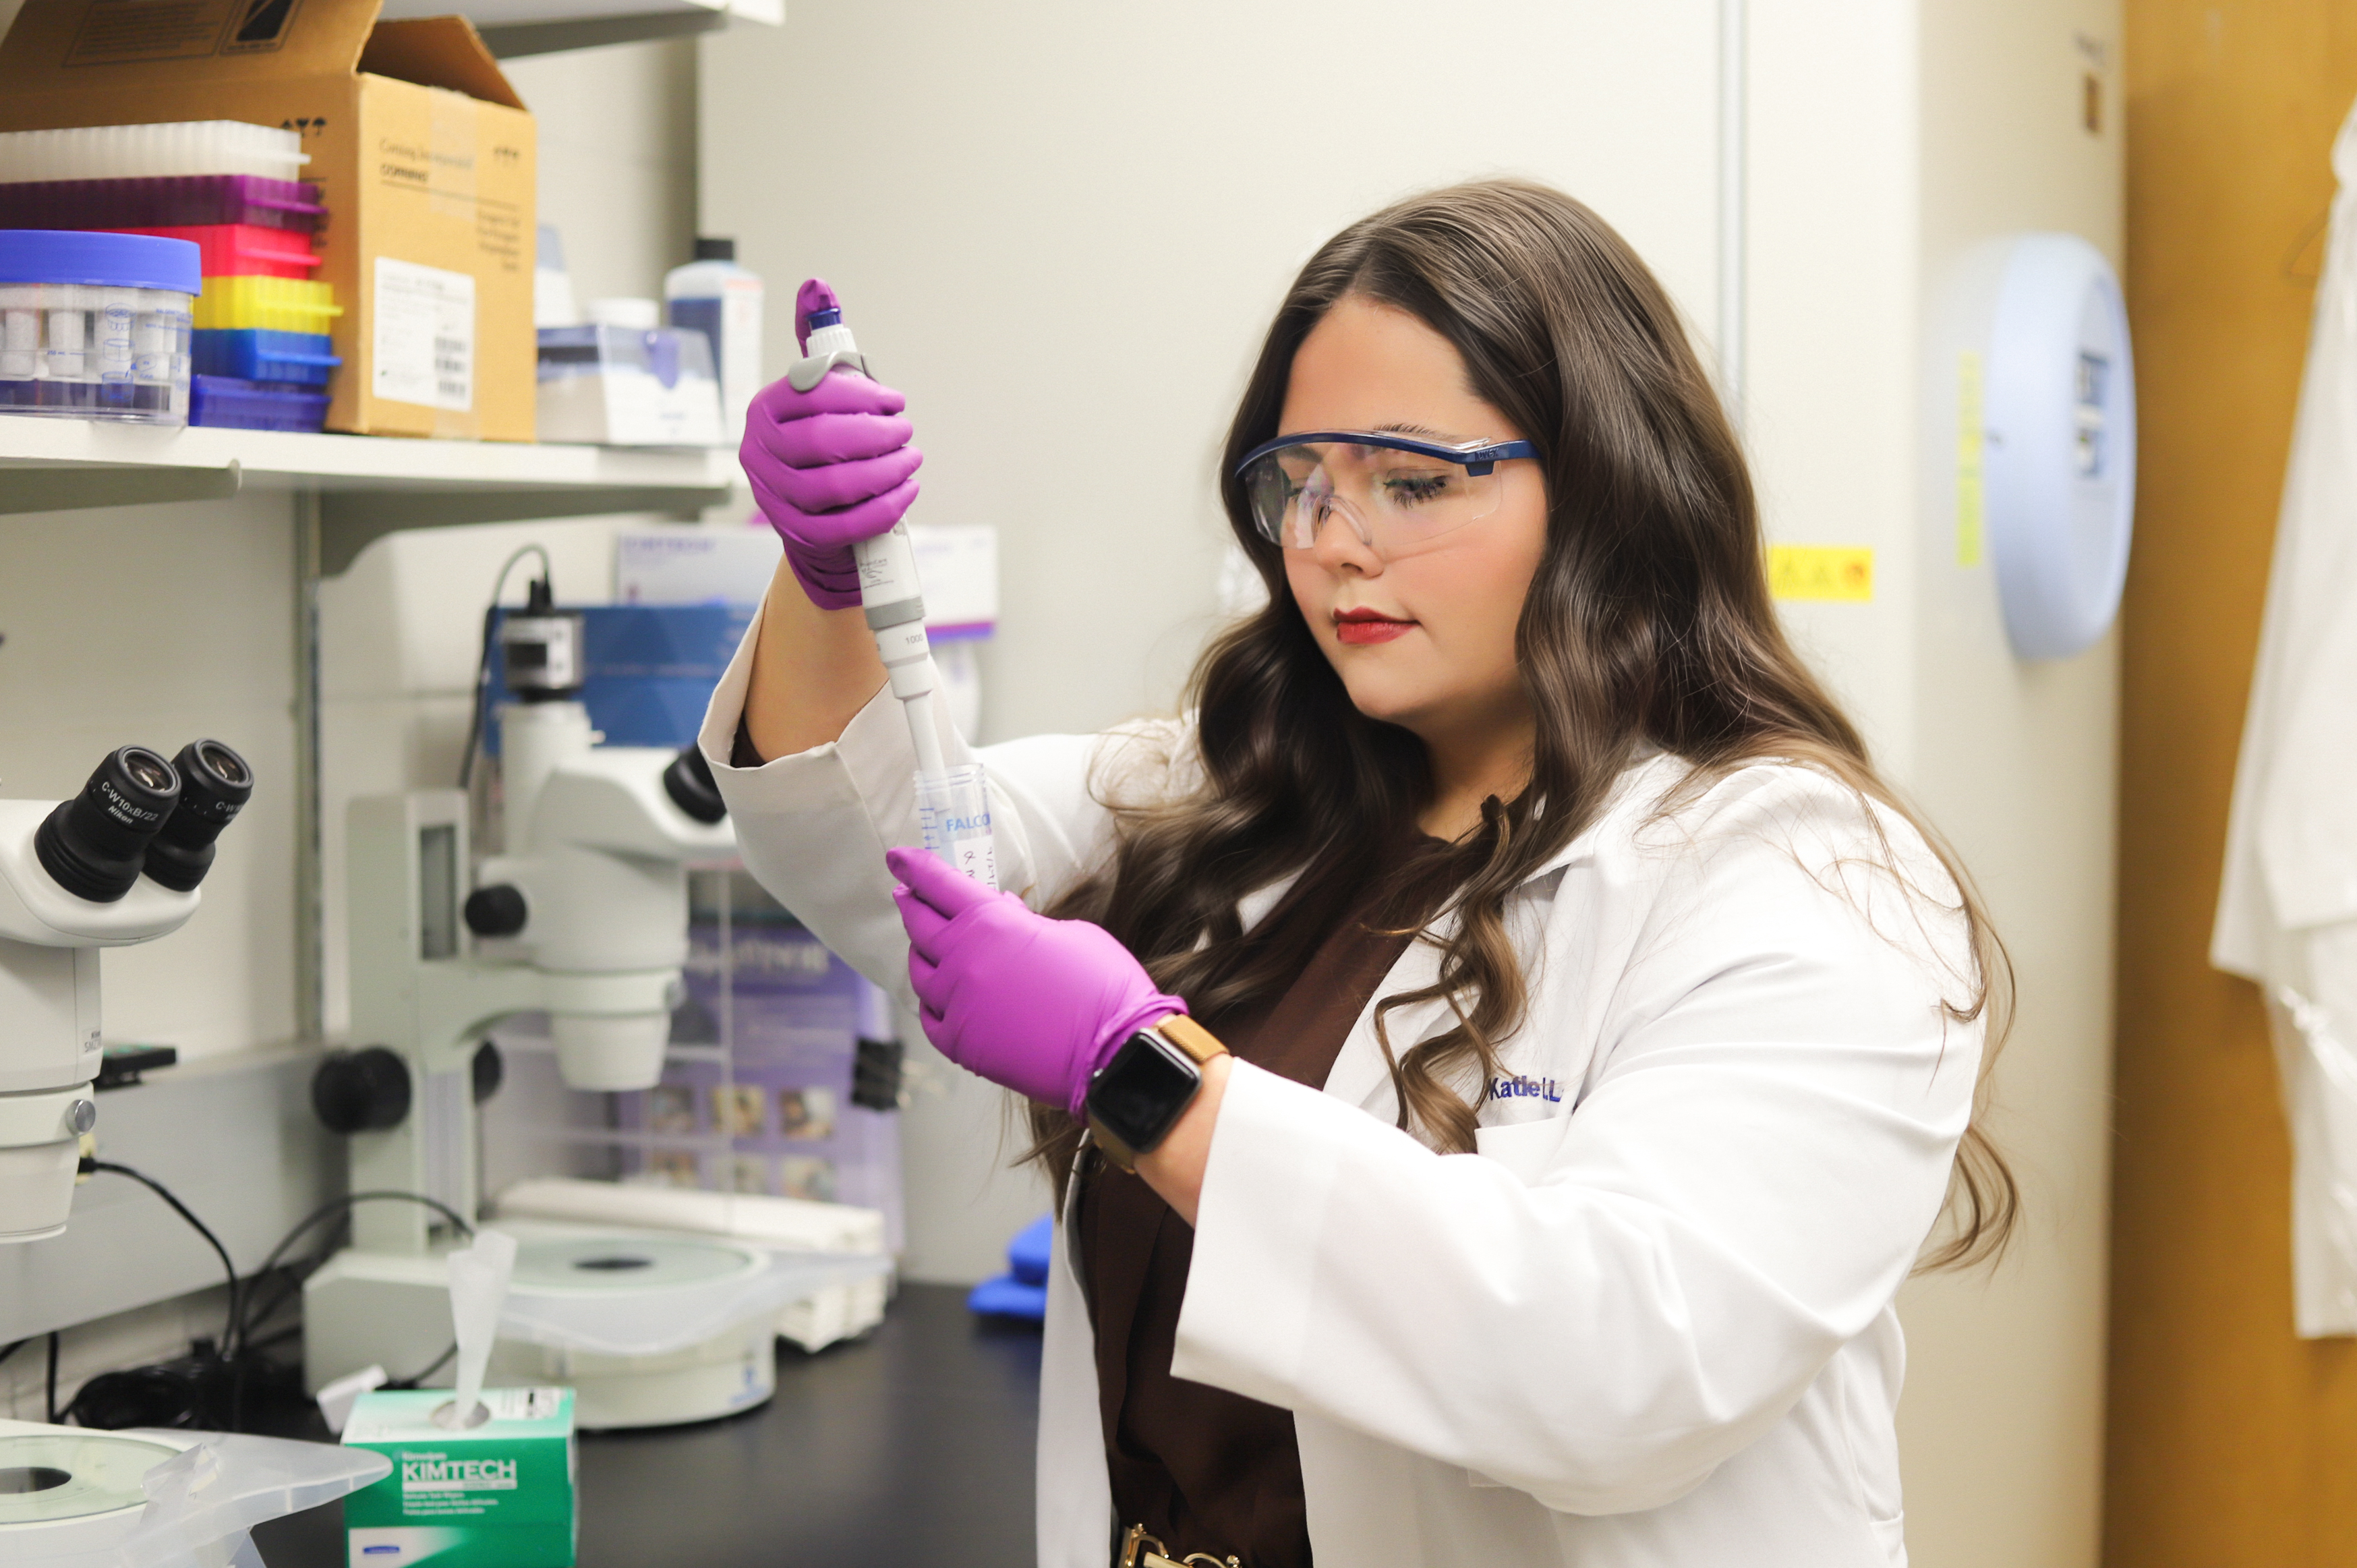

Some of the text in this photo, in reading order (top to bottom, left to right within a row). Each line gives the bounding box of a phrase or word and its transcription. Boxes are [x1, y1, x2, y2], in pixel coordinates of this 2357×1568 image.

[906, 633, 923, 645] 1000
[102, 782, 158, 821] C-W10xB/22
[108, 805, 134, 825] Nikon
[1489, 1075, 1540, 1101] Katie
[402, 1458, 517, 1482] KIMTECH
